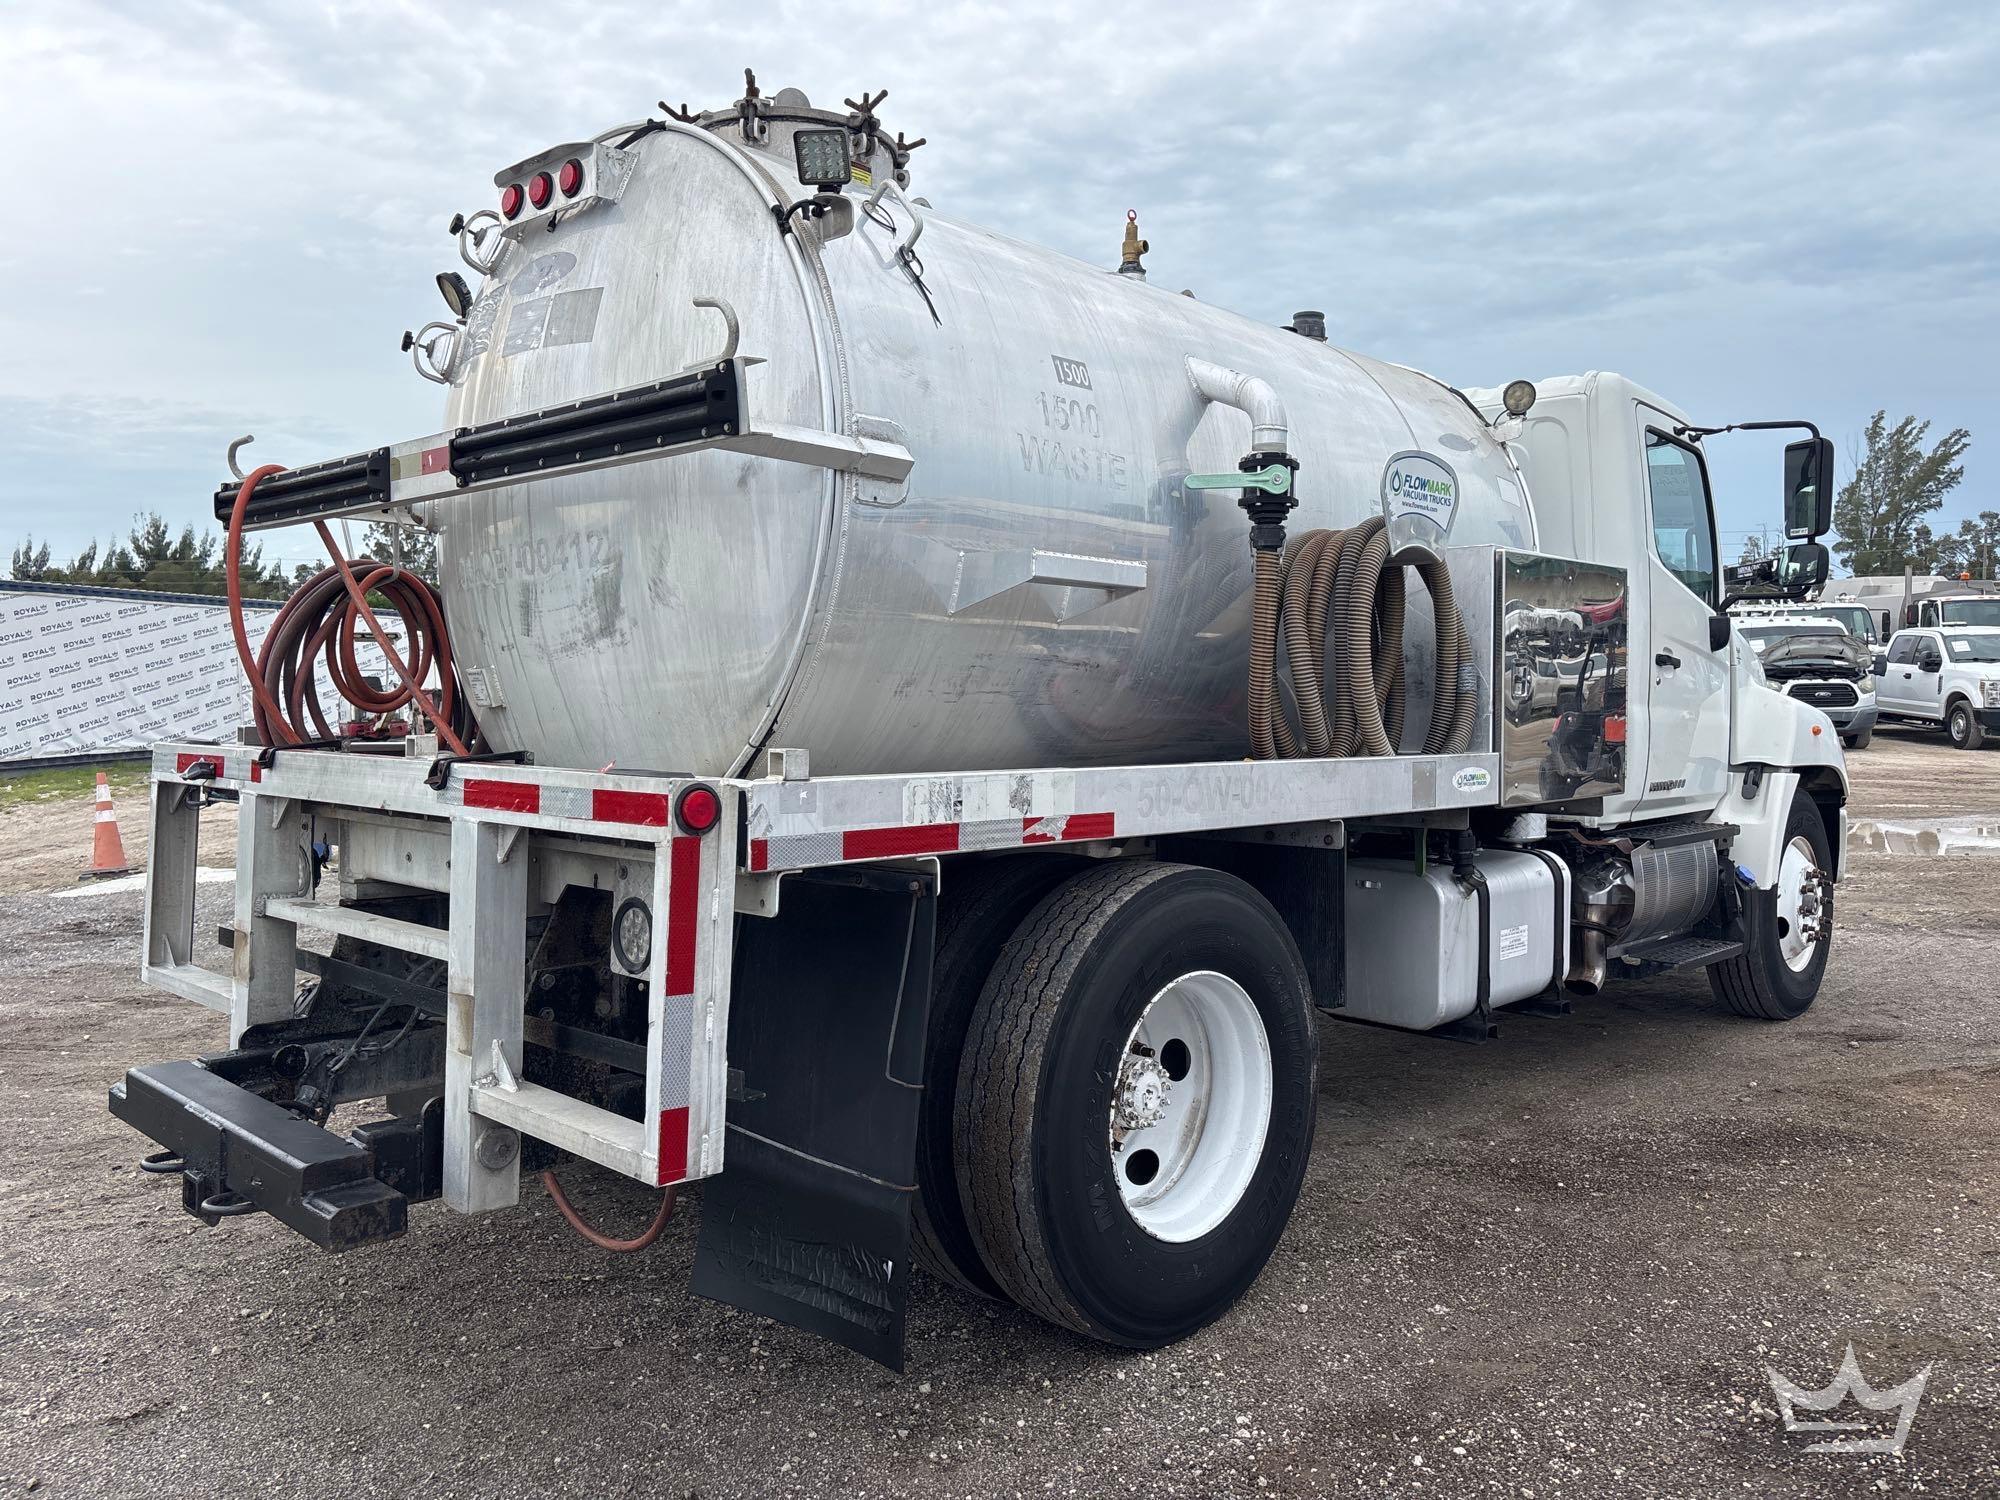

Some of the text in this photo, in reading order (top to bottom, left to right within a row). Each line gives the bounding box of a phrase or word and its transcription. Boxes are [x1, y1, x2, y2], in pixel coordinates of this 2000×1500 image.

[1055, 360, 1089, 386] 1500
[1035, 391, 1100, 438] 1500
[1017, 433, 1127, 491] WASTE
[1404, 474, 1452, 496] FLOWMARK
[1402, 489, 1452, 507] VACUUM TRUCKS
[56, 598, 80, 608] ROYAL
[14, 606, 40, 616] ROYAL
[118, 606, 140, 615] ROYAL
[80, 614, 104, 623] ROYAL
[173, 613, 194, 622] ROYAL
[40, 622, 66, 632] ROYAL
[139, 622, 160, 630] ROYAL
[102, 629, 125, 640] ROYAL
[193, 628, 213, 636] ROYAL
[64, 638, 88, 648] ROYAL
[161, 636, 182, 645] ROYAL
[210, 641, 230, 650] ROYAL
[22, 648, 48, 658] ROYAL
[125, 644, 148, 654] ROYAL
[88, 654, 112, 664] ROYAL
[179, 650, 199, 660] ROYAL
[145, 658, 168, 669] ROYAL
[200, 664, 218, 673] ROYAL
[48, 664, 74, 674] ROYAL
[109, 668, 132, 679] ROYAL
[7, 674, 34, 686] ROYAL
[167, 674, 188, 682] ROYAL
[71, 679, 96, 690] ROYAL
[132, 682, 154, 692] ROYAL
[30, 690, 57, 700] ROYAL
[185, 686, 205, 696] ROYAL
[96, 692, 118, 704] ROYAL
[152, 696, 174, 706] ROYAL
[205, 698, 225, 708] ROYAL
[56, 704, 81, 716] ROYAL
[117, 706, 139, 718] ROYAL
[173, 708, 194, 719] ROYAL
[16, 716, 42, 728] ROYAL
[79, 718, 103, 730] ROYAL
[140, 720, 162, 730] ROYAL
[192, 722, 212, 732] ROYAL
[39, 731, 64, 742] ROYAL
[103, 732, 125, 743] ROYAL
